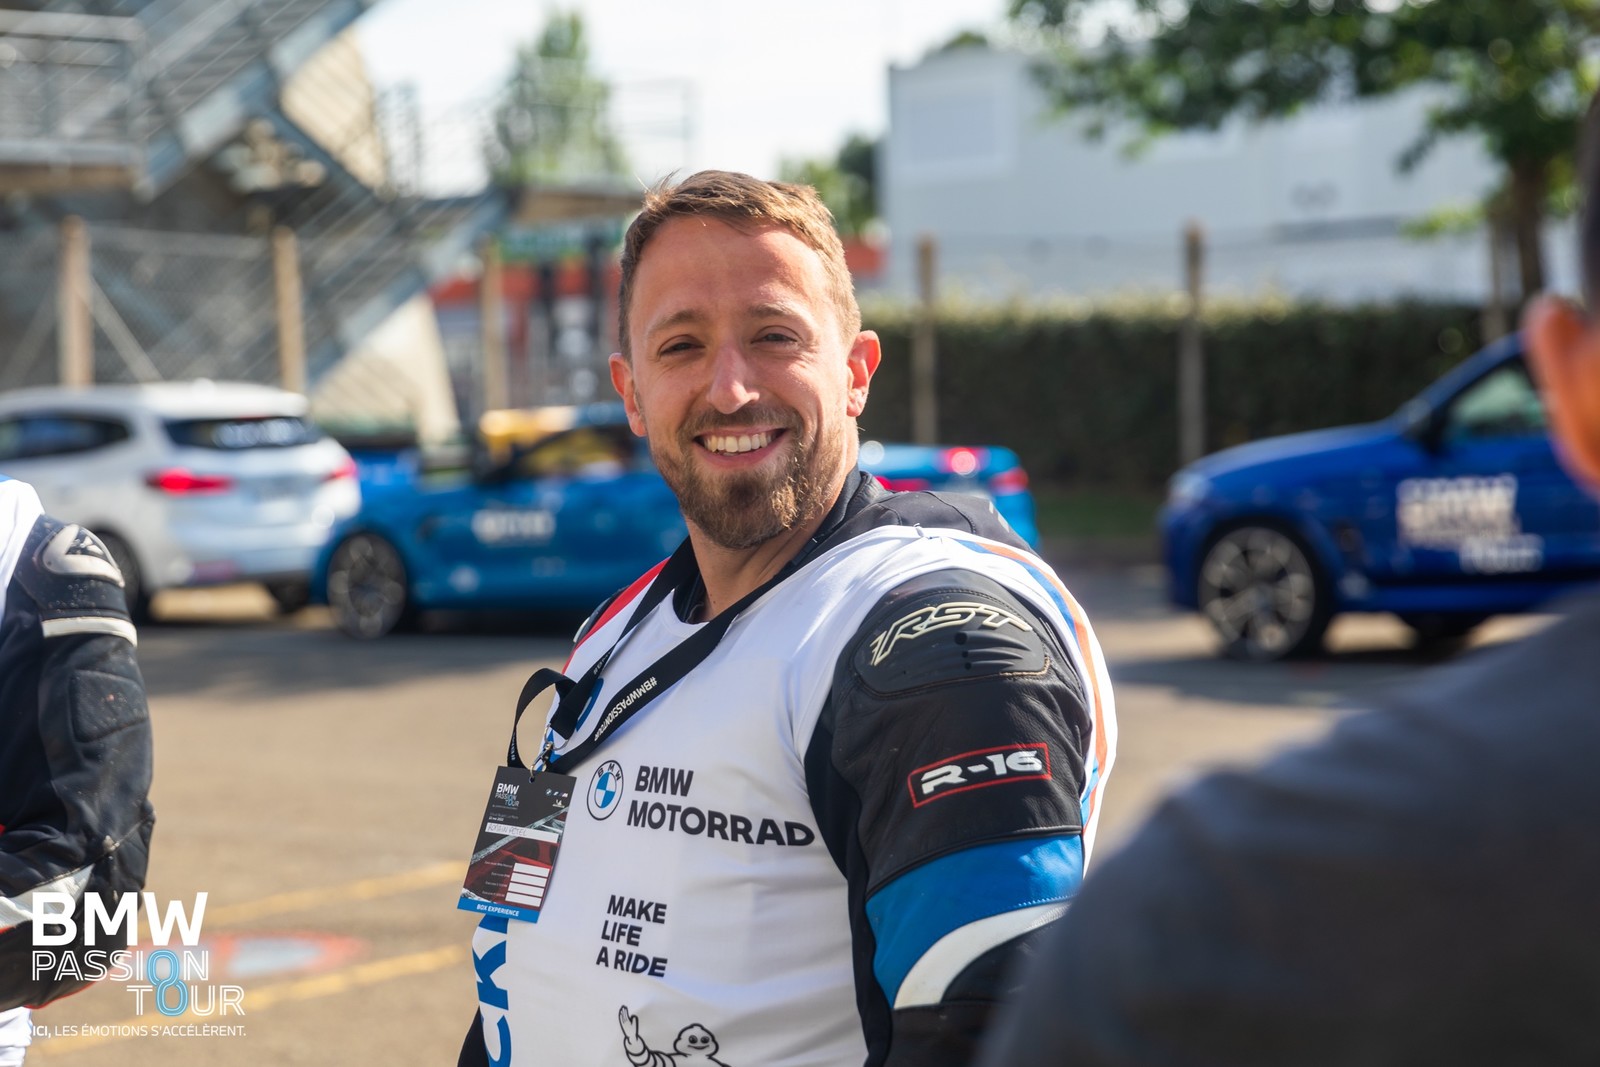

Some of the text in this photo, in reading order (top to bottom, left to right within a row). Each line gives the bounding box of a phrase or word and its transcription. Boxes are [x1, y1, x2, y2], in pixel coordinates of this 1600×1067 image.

[869, 602, 1033, 666] RST
[594, 676, 658, 742] #BMWPASSIONTOUR
[598, 762, 622, 781] BMW
[635, 765, 694, 797] BMW
[920, 750, 1043, 795] R-16
[496, 783, 520, 795] BMW
[505, 799, 520, 807] TOUR
[627, 800, 815, 847] MOTORRAD
[476, 903, 520, 917] BOX EXPERIENCE
[607, 894, 667, 924] MAKE
[601, 919, 642, 947] LIFE
[595, 946, 668, 978] A RIDE
